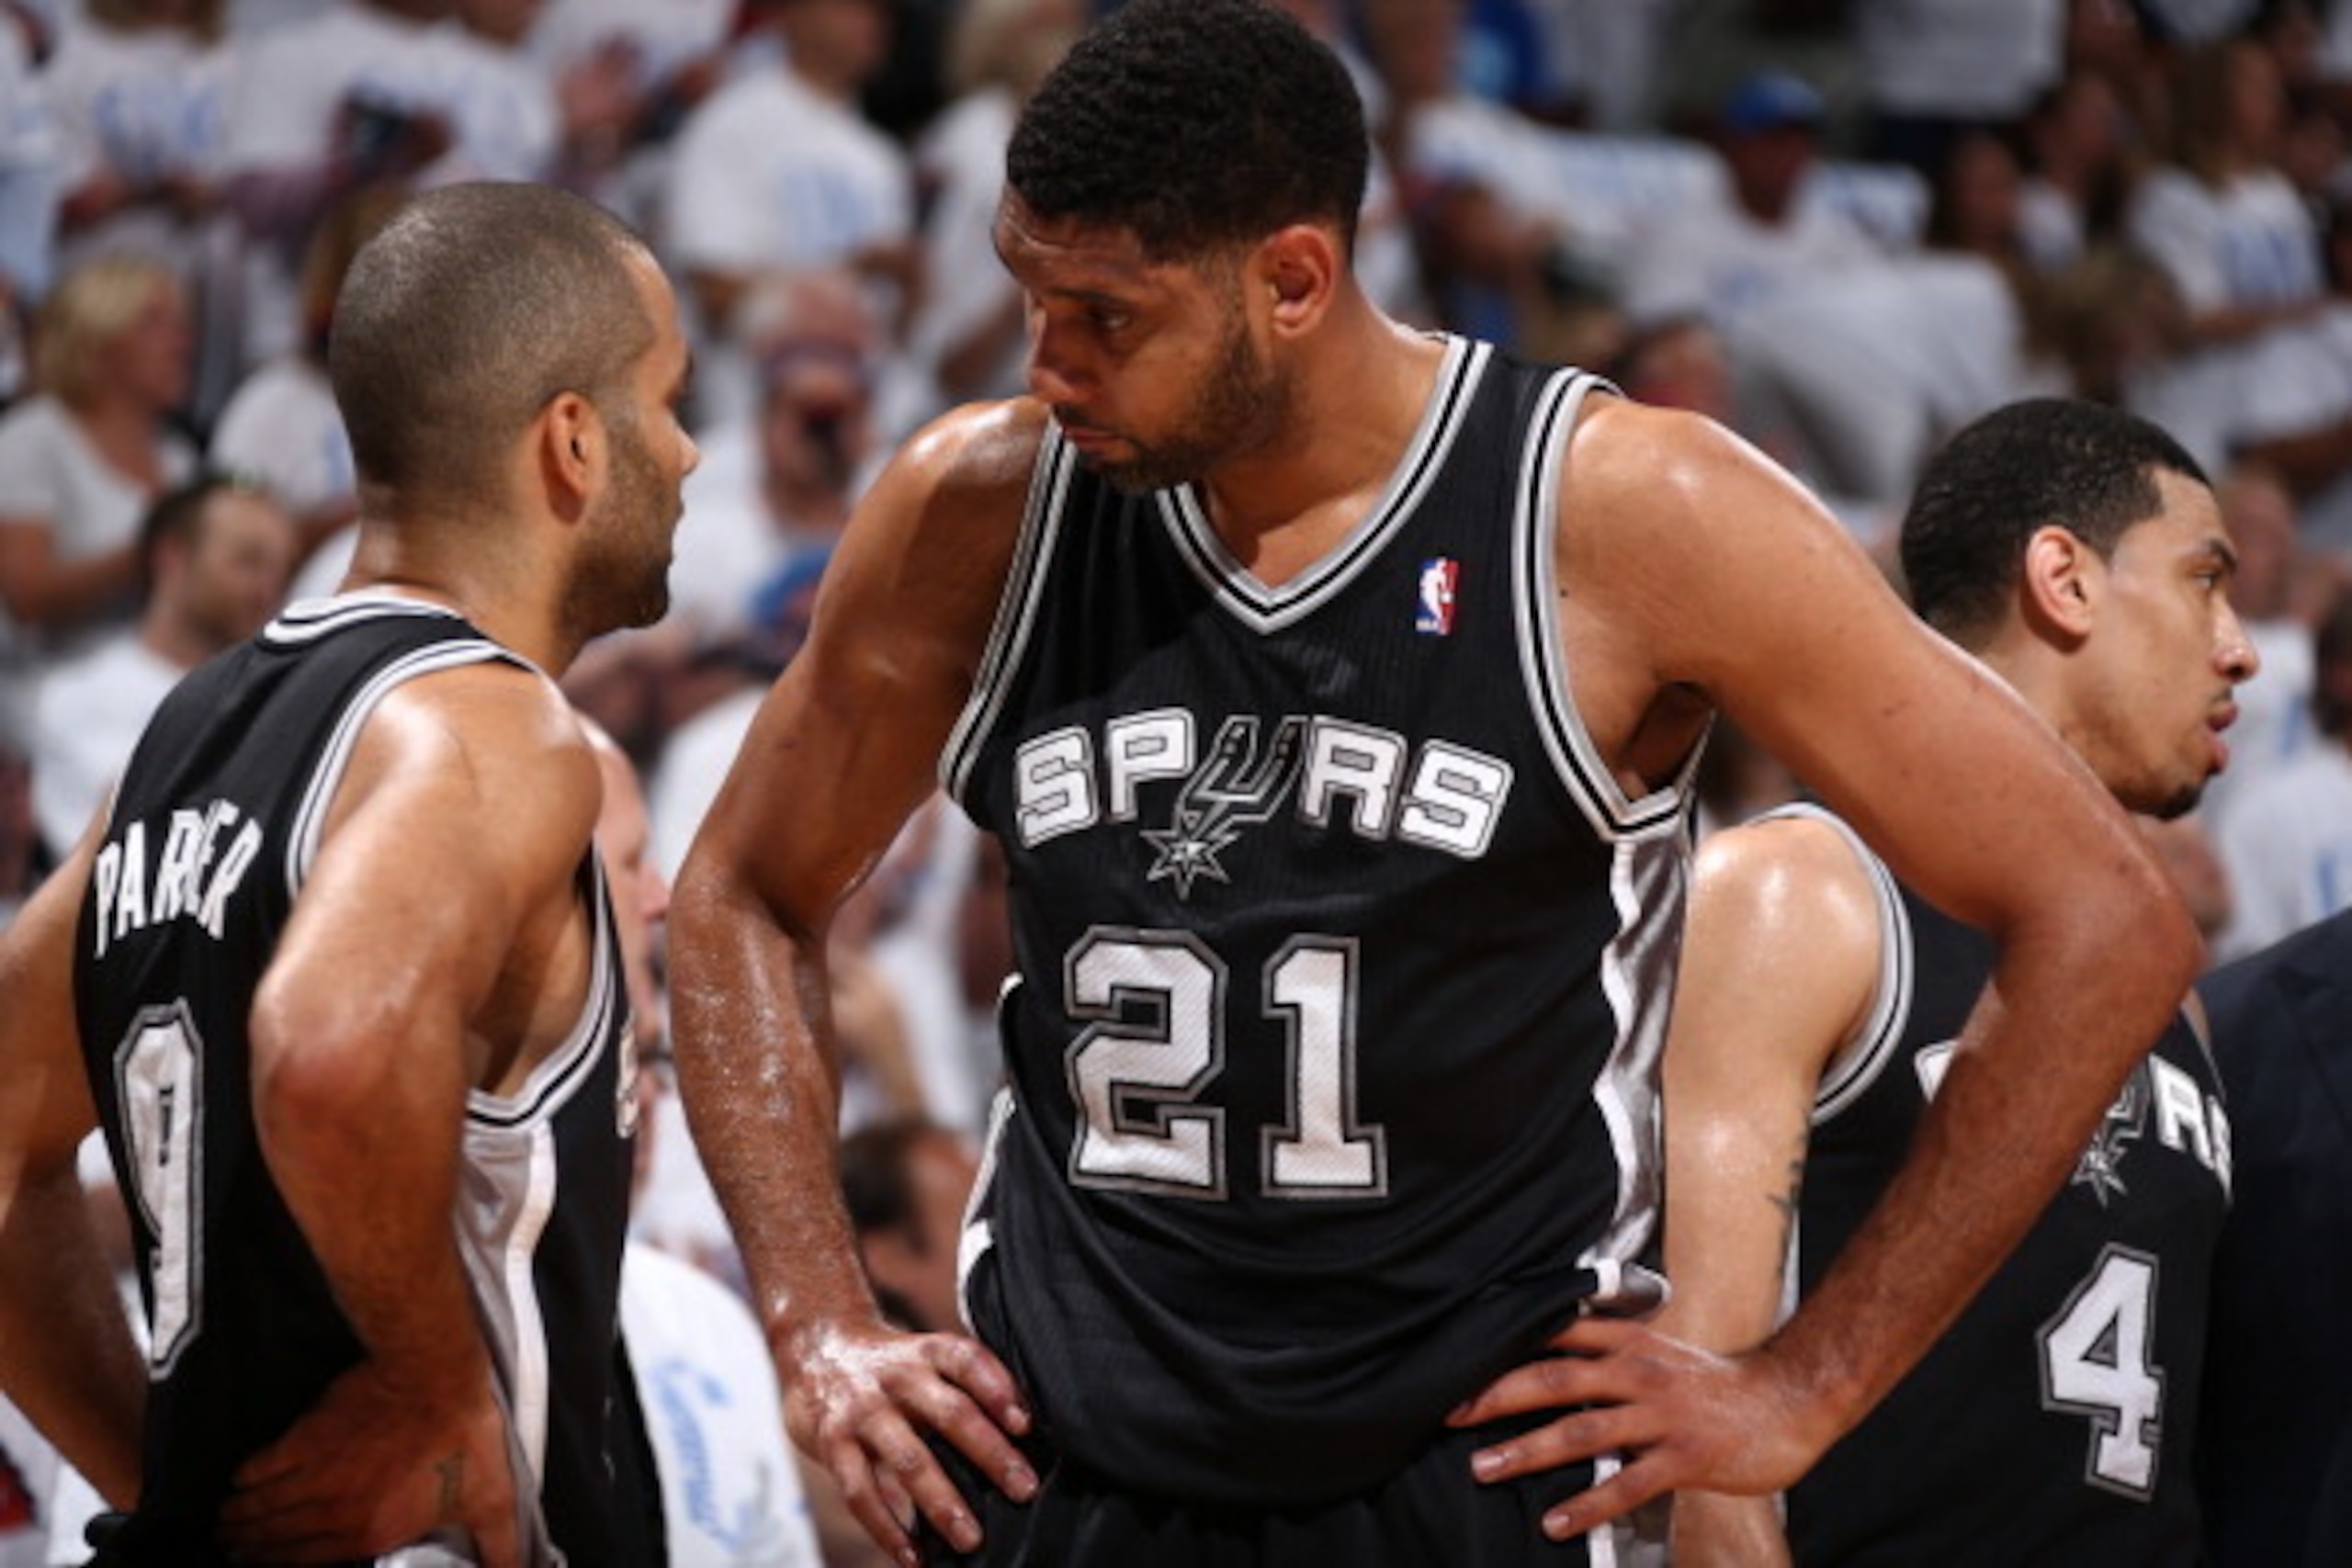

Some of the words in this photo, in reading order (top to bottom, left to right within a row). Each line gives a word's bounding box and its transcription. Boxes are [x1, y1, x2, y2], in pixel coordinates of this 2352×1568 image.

[1015, 706, 1515, 898] SPURS
[113, 996, 204, 1382] 9
[1063, 922, 1387, 1201] 21
[2035, 1242, 2165, 1503] 4
